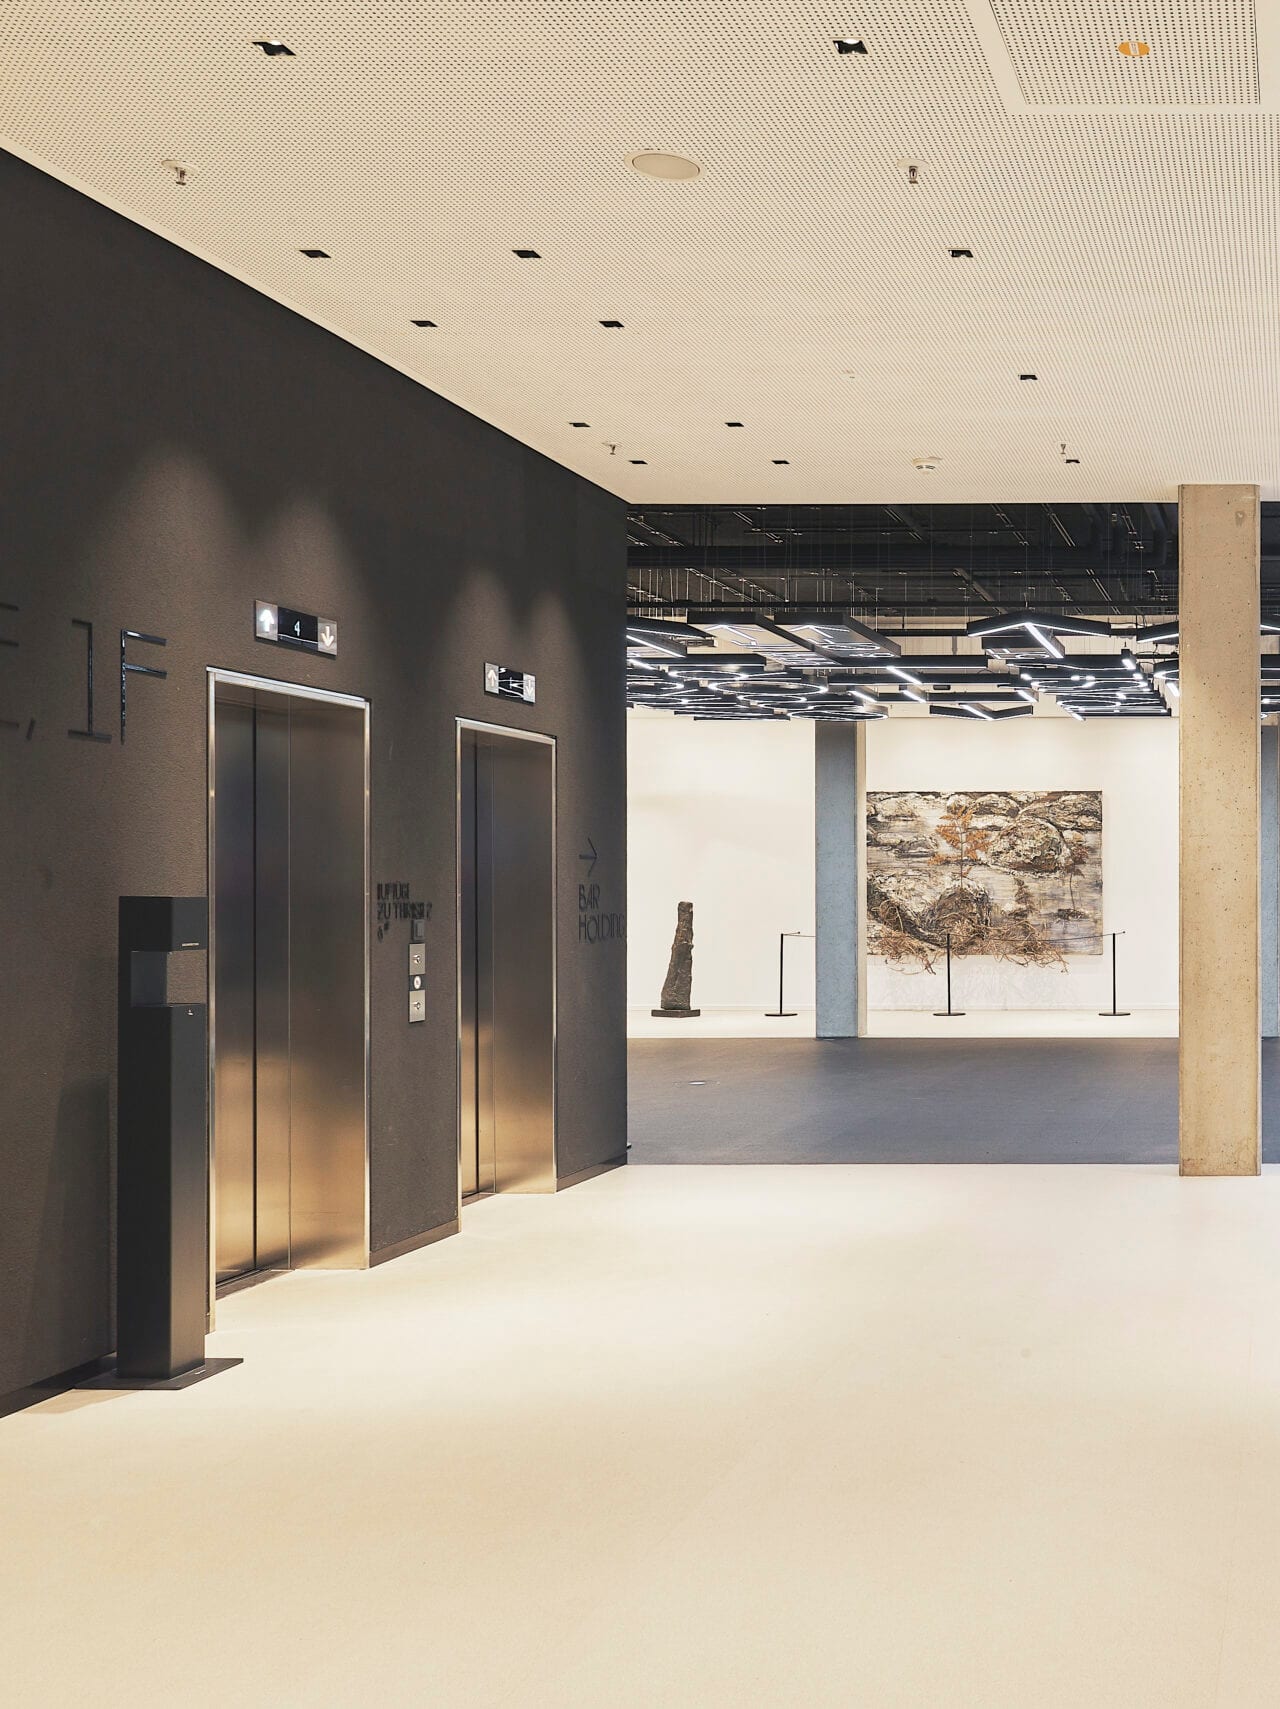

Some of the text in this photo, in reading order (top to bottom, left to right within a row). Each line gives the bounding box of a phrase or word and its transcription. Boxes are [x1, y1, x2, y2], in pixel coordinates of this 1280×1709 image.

[294, 620, 300, 637] 4
[579, 884, 600, 912] BAR
[579, 913, 625, 944] HOLDING
